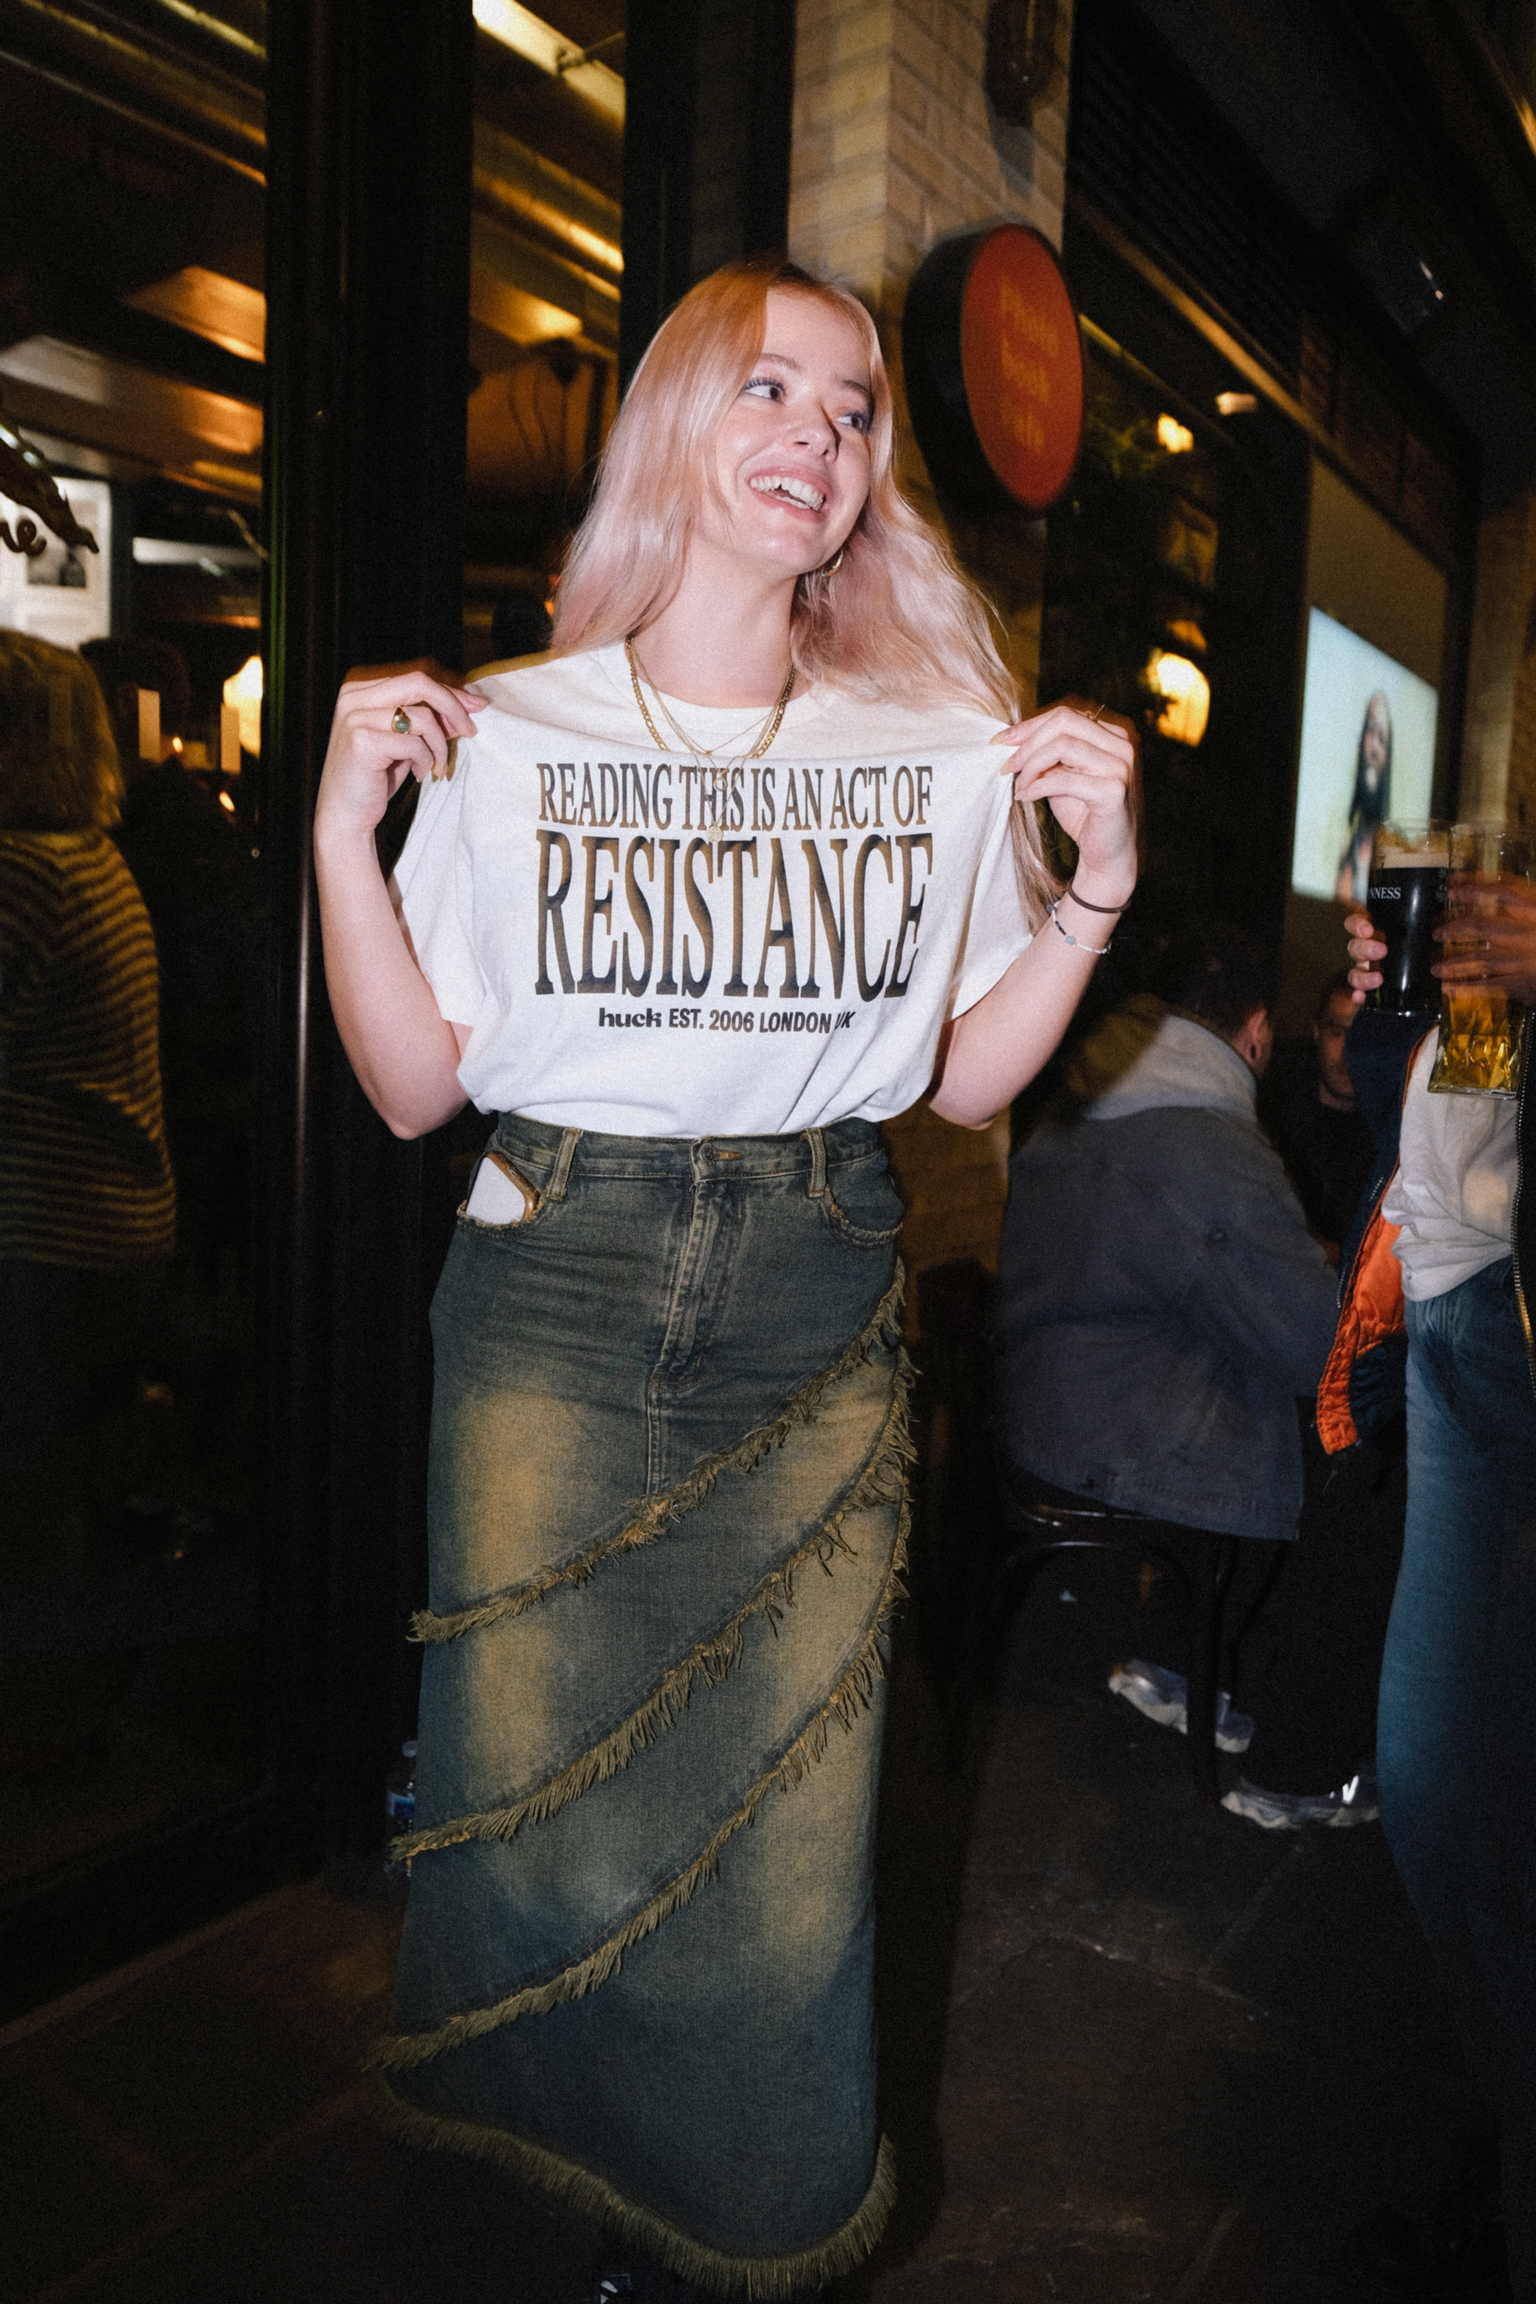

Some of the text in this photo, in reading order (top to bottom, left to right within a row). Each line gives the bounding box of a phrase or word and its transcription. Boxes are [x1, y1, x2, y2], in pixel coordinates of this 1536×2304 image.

[537, 762, 933, 832] READING THIS IS AN ACT OF
[534, 829, 933, 1002] RESISTANCE
[598, 1008, 857, 1034] huck EST. 2006 LONDON UK
